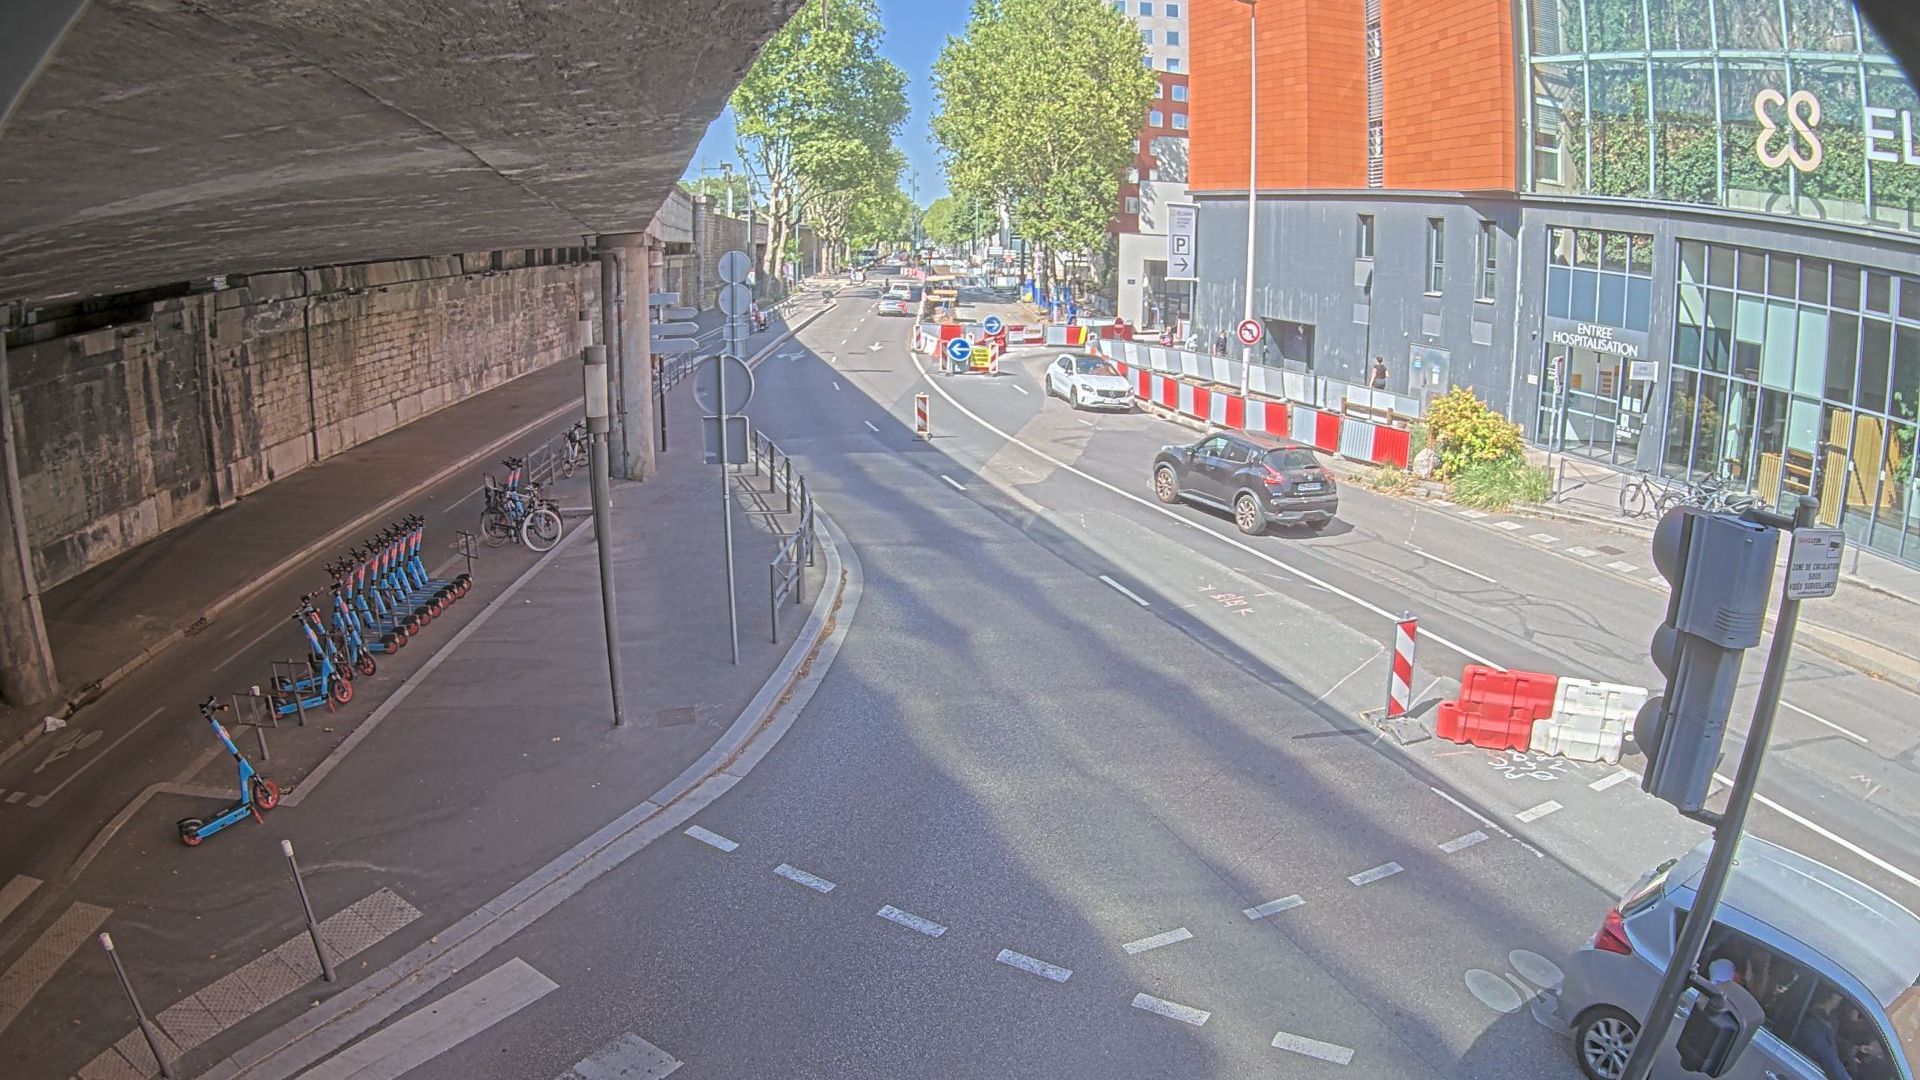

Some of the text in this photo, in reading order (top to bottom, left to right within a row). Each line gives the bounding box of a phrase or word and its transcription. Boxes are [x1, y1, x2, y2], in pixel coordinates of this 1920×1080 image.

[1864, 107, 1920, 165] EL
[1176, 237, 1186, 252] P
[1552, 331, 1638, 357] HOSPITALISATION
[1792, 563, 1804, 571] ZONE
[1805, 563, 1813, 571] DE
